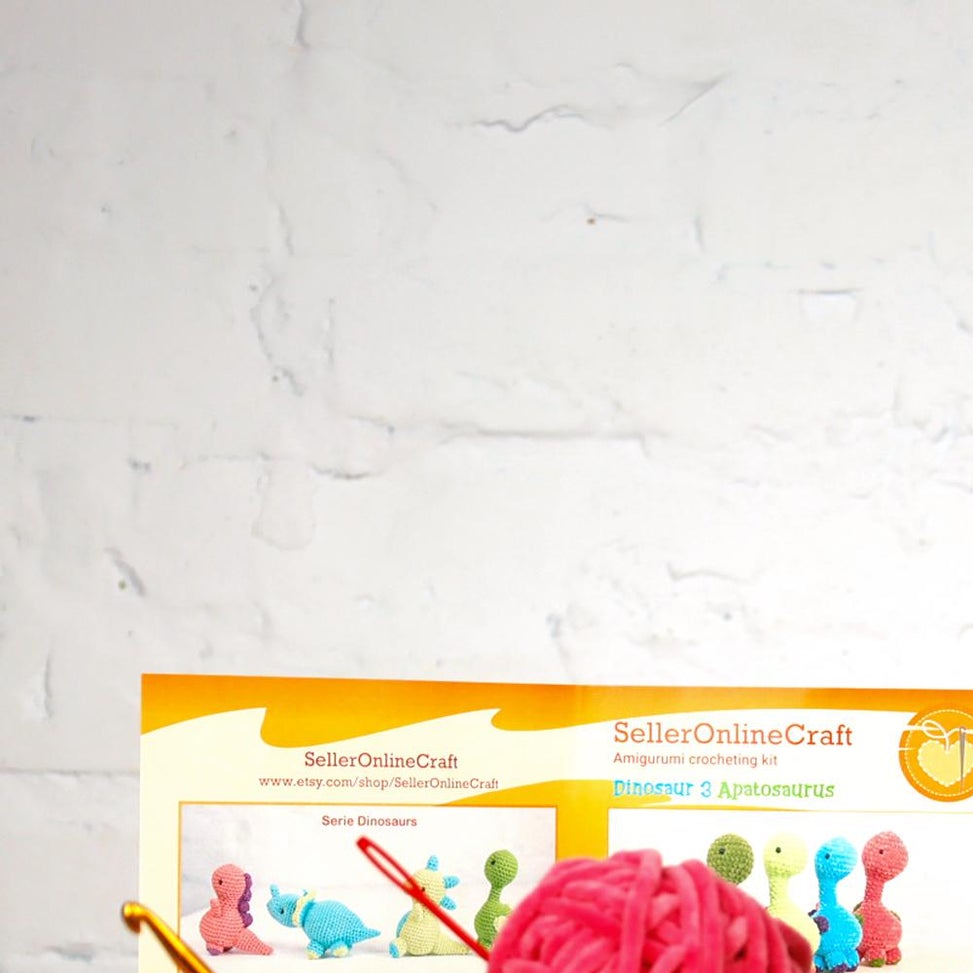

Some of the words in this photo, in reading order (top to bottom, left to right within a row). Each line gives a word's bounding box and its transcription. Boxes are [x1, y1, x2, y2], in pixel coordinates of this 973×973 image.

[613, 722, 853, 746] SellerOnlineCraft
[304, 751, 459, 769] SellerOnlineCraft
[613, 752, 685, 767] Amigurumi
[689, 754, 758, 768] crocheting
[762, 754, 778, 766] kit
[258, 776, 500, 790] www.etsy.com/shop/SellerOnlineCraft
[613, 779, 694, 797] Dinosaur
[700, 780, 712, 798] 3
[717, 780, 835, 800] Apatosaurus
[321, 815, 354, 827] Serie
[357, 815, 418, 827] Dinosaurs
